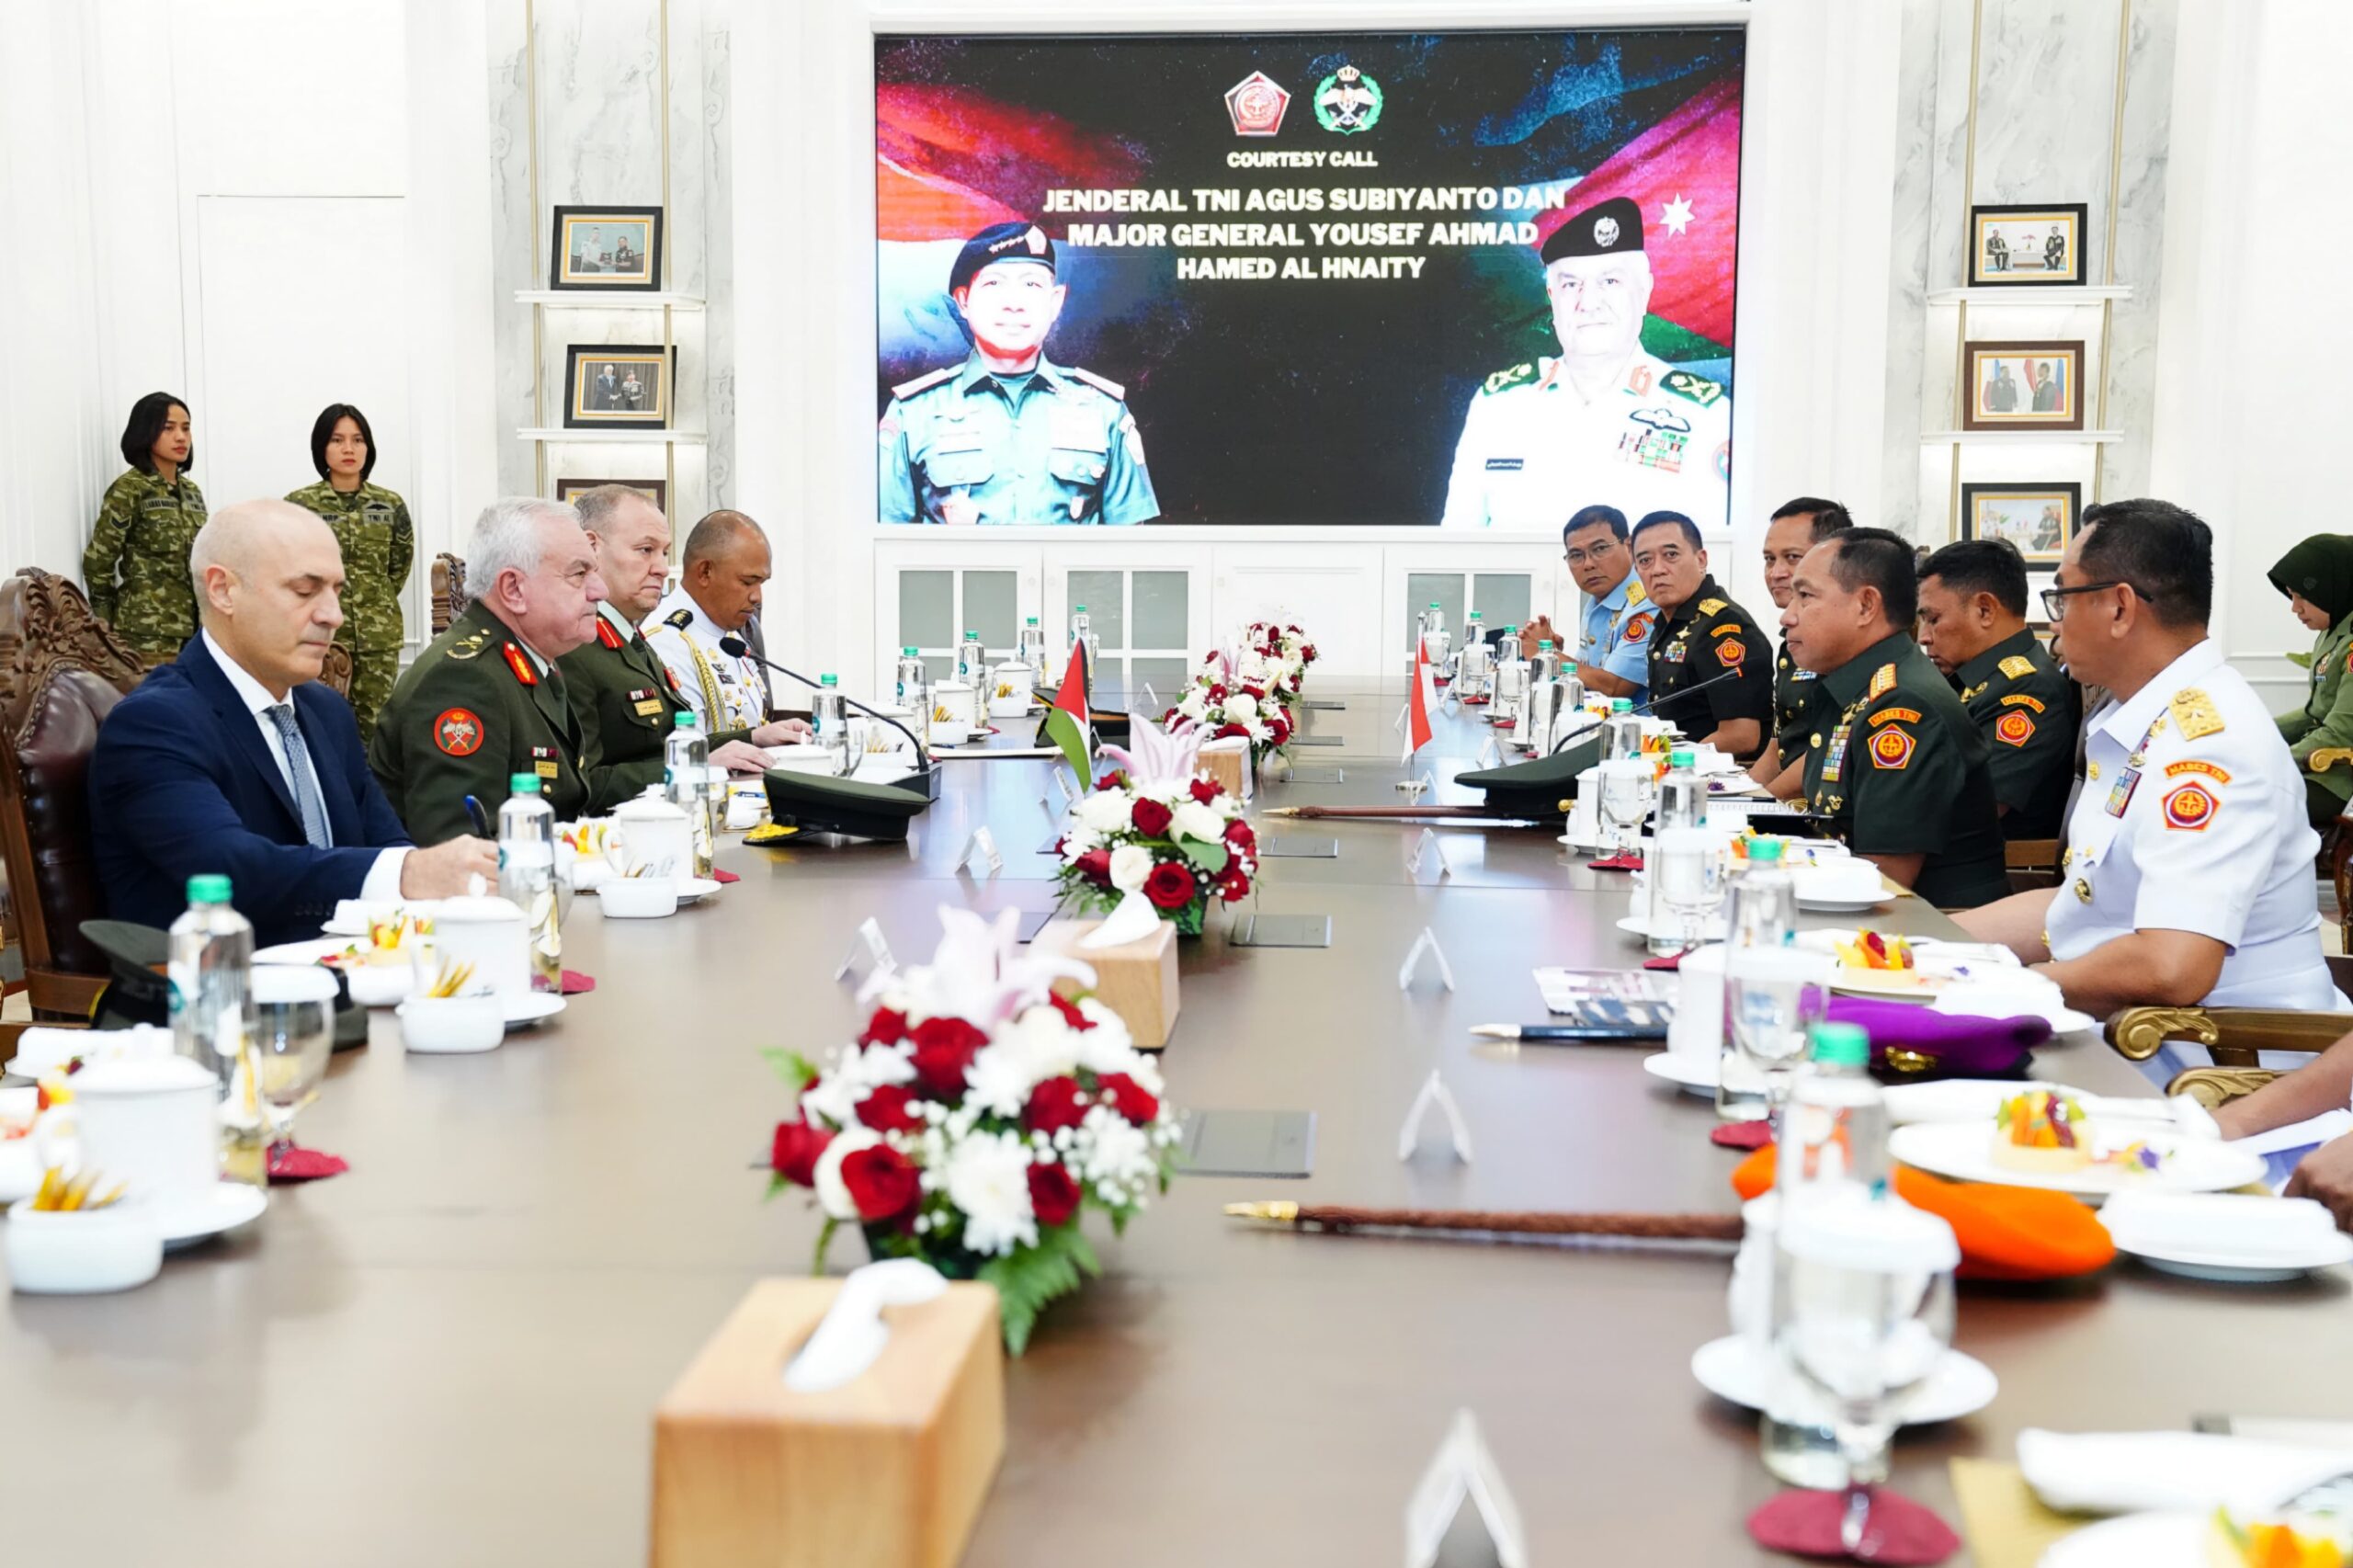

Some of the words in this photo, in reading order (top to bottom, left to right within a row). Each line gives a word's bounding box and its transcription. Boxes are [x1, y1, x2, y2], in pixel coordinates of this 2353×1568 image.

[1227, 151, 1326, 167] COURTESY
[1329, 151, 1378, 166] CALL
[1043, 188, 1188, 212] JENDERAL
[1193, 188, 1240, 211] TNI
[1245, 187, 1324, 211] AGUS
[1329, 187, 1495, 211] SUBIYANTO
[1503, 186, 1565, 210] DAN
[1067, 223, 1166, 246] MAJOR
[1171, 223, 1303, 246] GENERAL
[1309, 222, 1423, 245] YOUSEF
[1428, 222, 1539, 244] AHMAD
[1177, 256, 1276, 279] HAMED
[1281, 256, 1317, 278] AL
[1323, 256, 1426, 278] HNAITY
[2169, 762, 2208, 775] MABES
[2210, 767, 2227, 782] TNI
